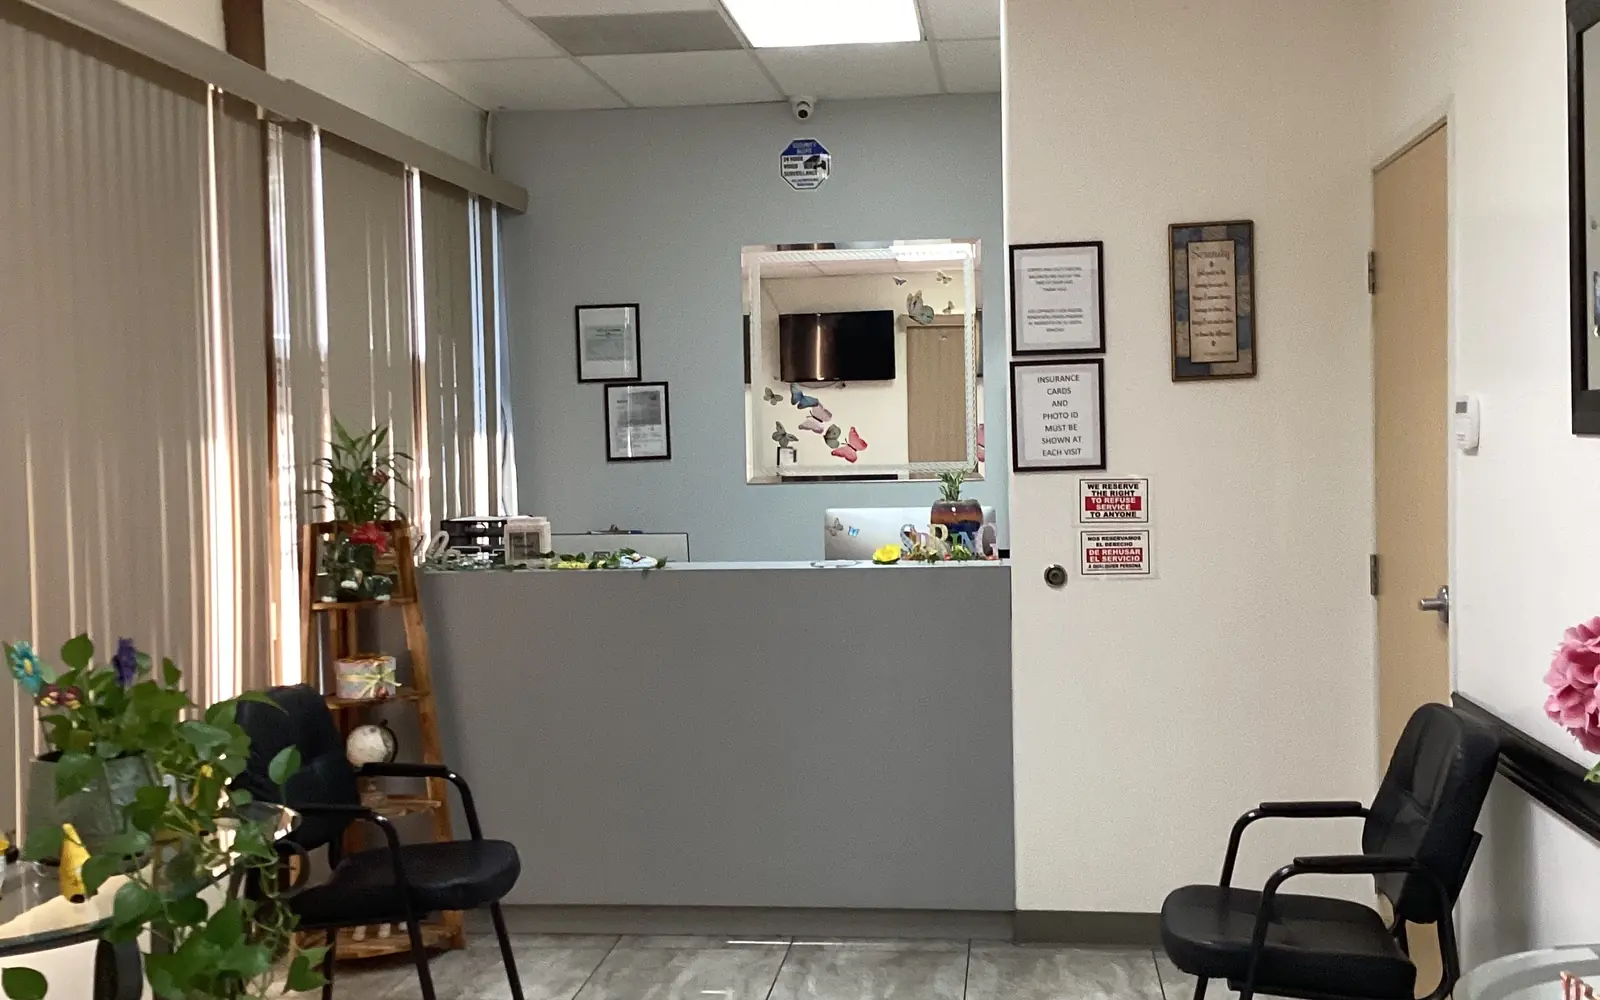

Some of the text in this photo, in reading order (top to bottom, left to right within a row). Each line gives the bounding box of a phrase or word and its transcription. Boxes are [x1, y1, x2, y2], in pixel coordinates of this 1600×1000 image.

[1037, 374, 1079, 383] INSURANCE
[1047, 387, 1072, 395] CARDS
[1043, 412, 1069, 420] PHOTO
